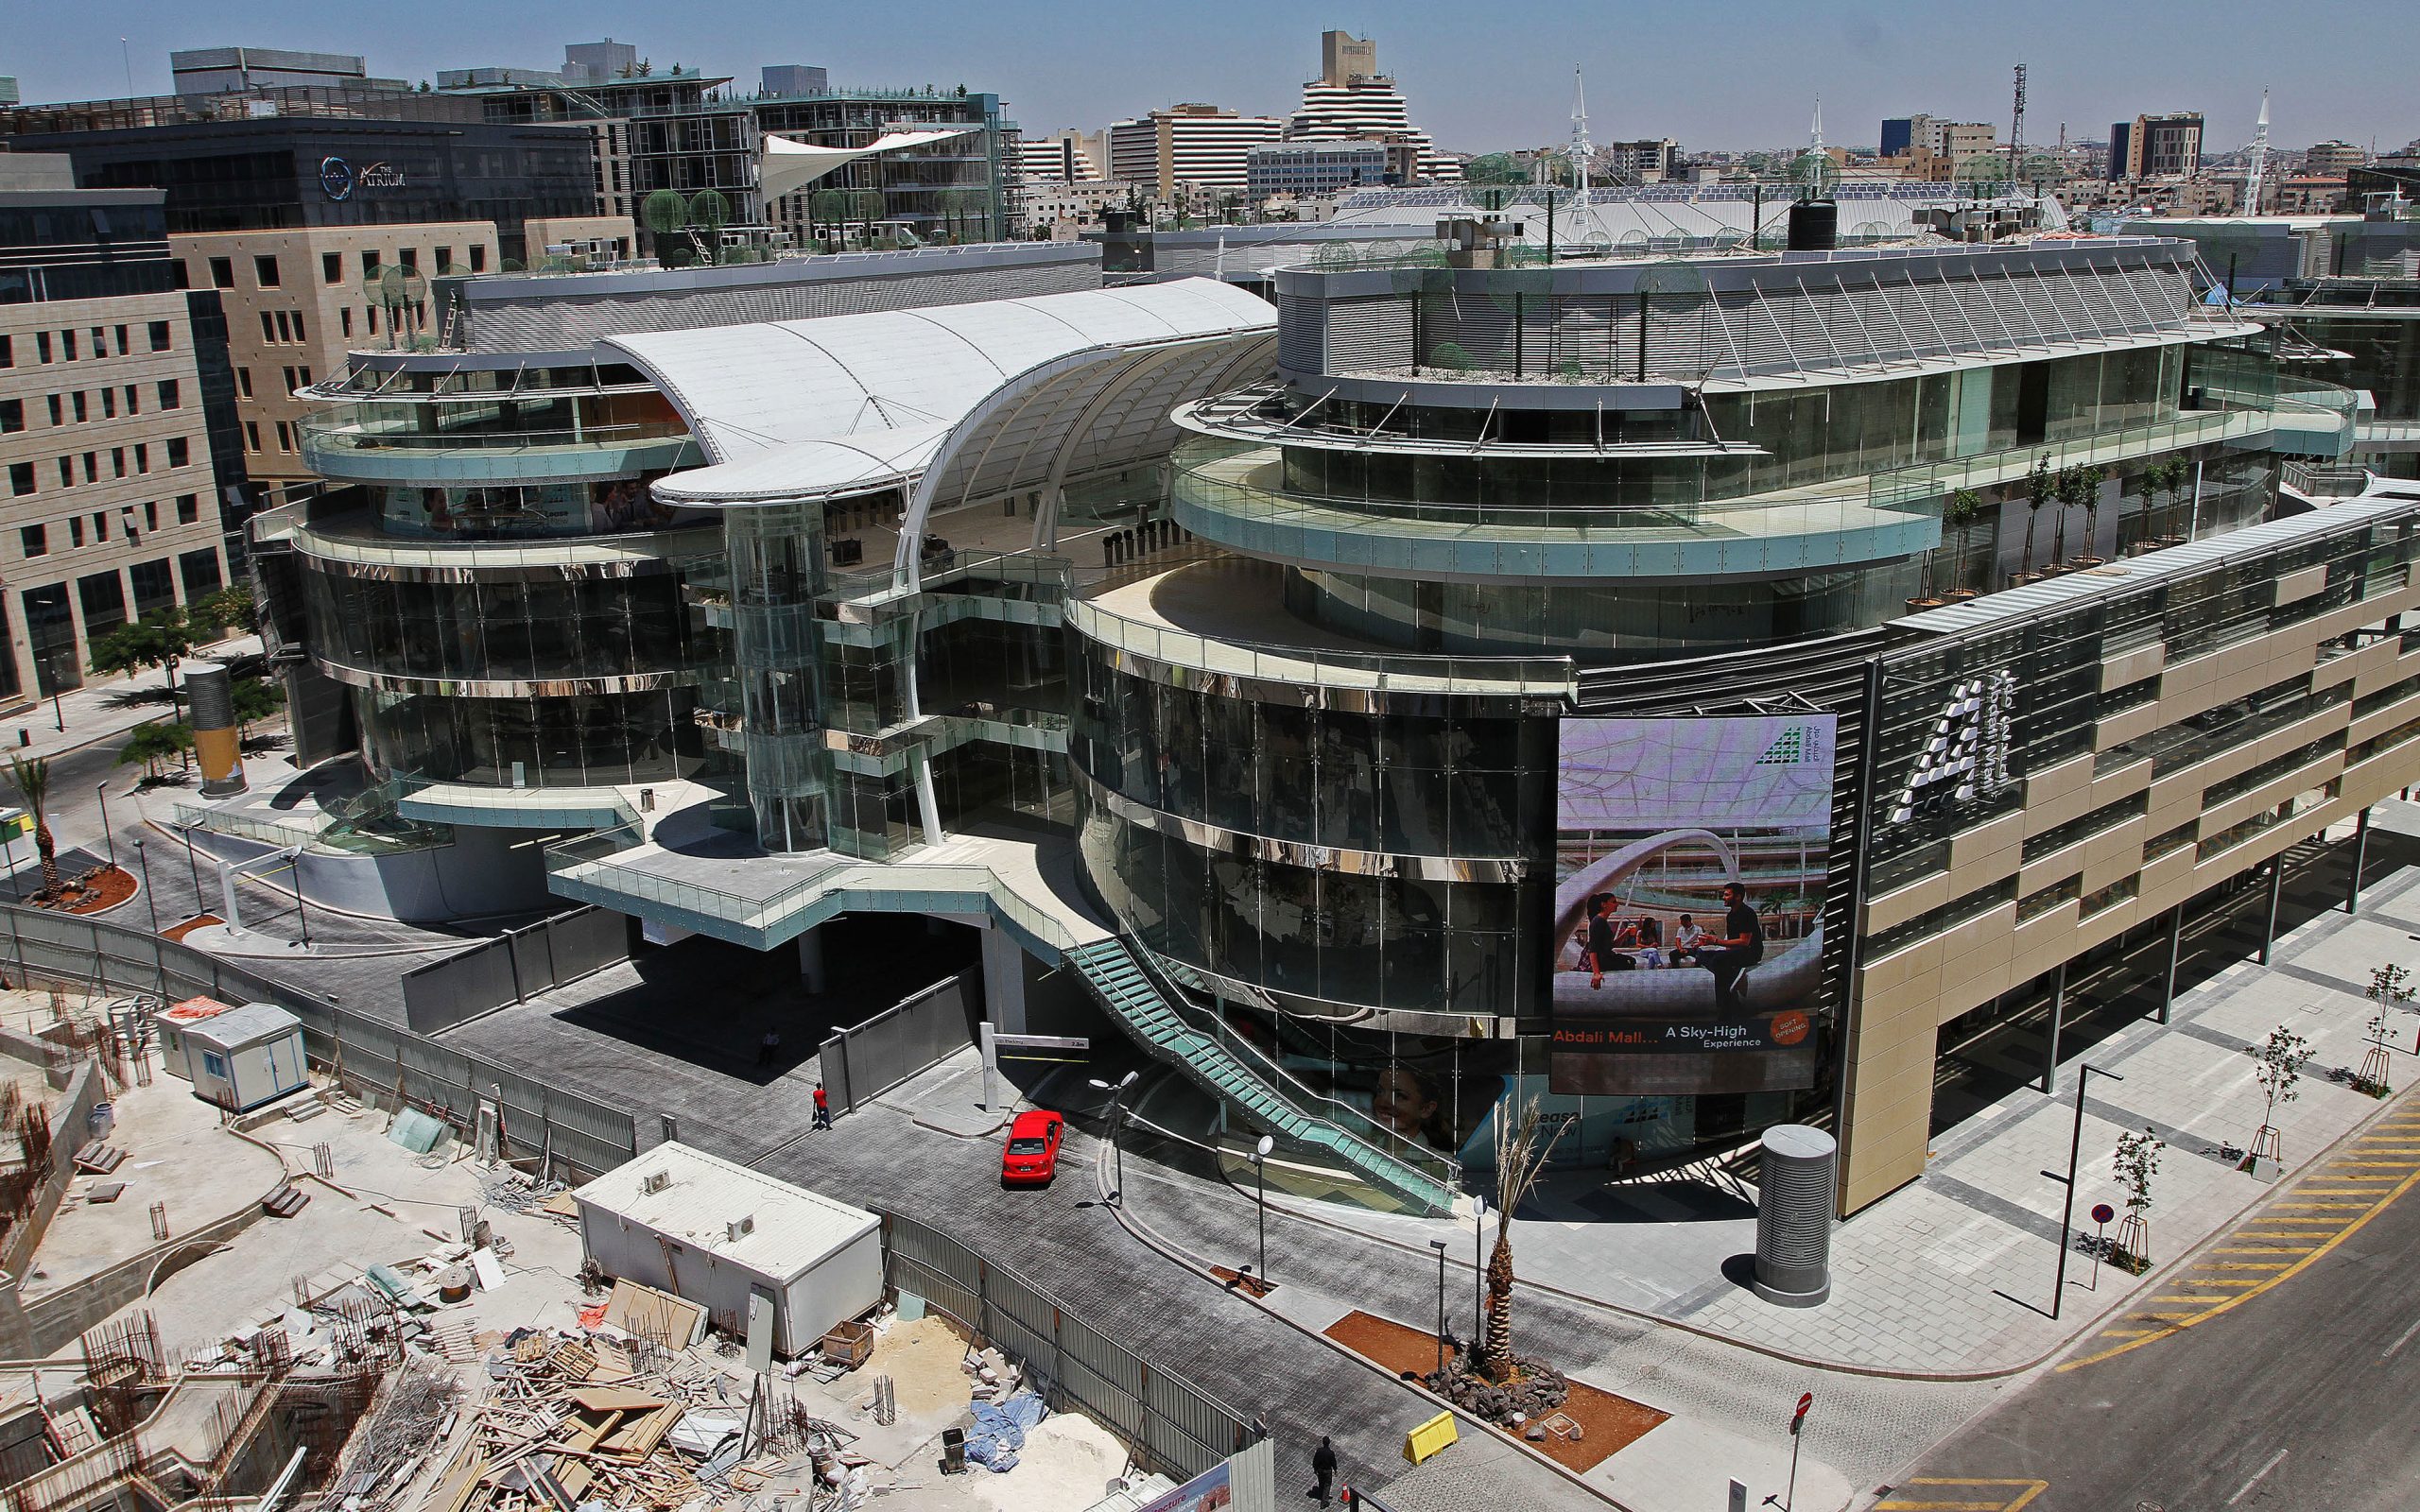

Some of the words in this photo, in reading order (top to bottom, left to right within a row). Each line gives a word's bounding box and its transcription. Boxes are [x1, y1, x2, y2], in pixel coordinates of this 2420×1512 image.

[359, 165, 406, 186] ATRIUM
[1986, 675, 2002, 742] Abdali
[1982, 745, 1997, 790] Mall
[1776, 1023, 1806, 1038] OPENING
[1780, 1019, 1796, 1030] SOFT
[1554, 1030, 1603, 1043] Abdali
[1666, 1028, 1676, 1038] A
[1680, 1025, 1747, 1039] Sky-High
[1703, 1039, 1762, 1049] Experience
[1537, 1111, 1579, 1124] ease
[1177, 1494, 1205, 1512] Jordan's
